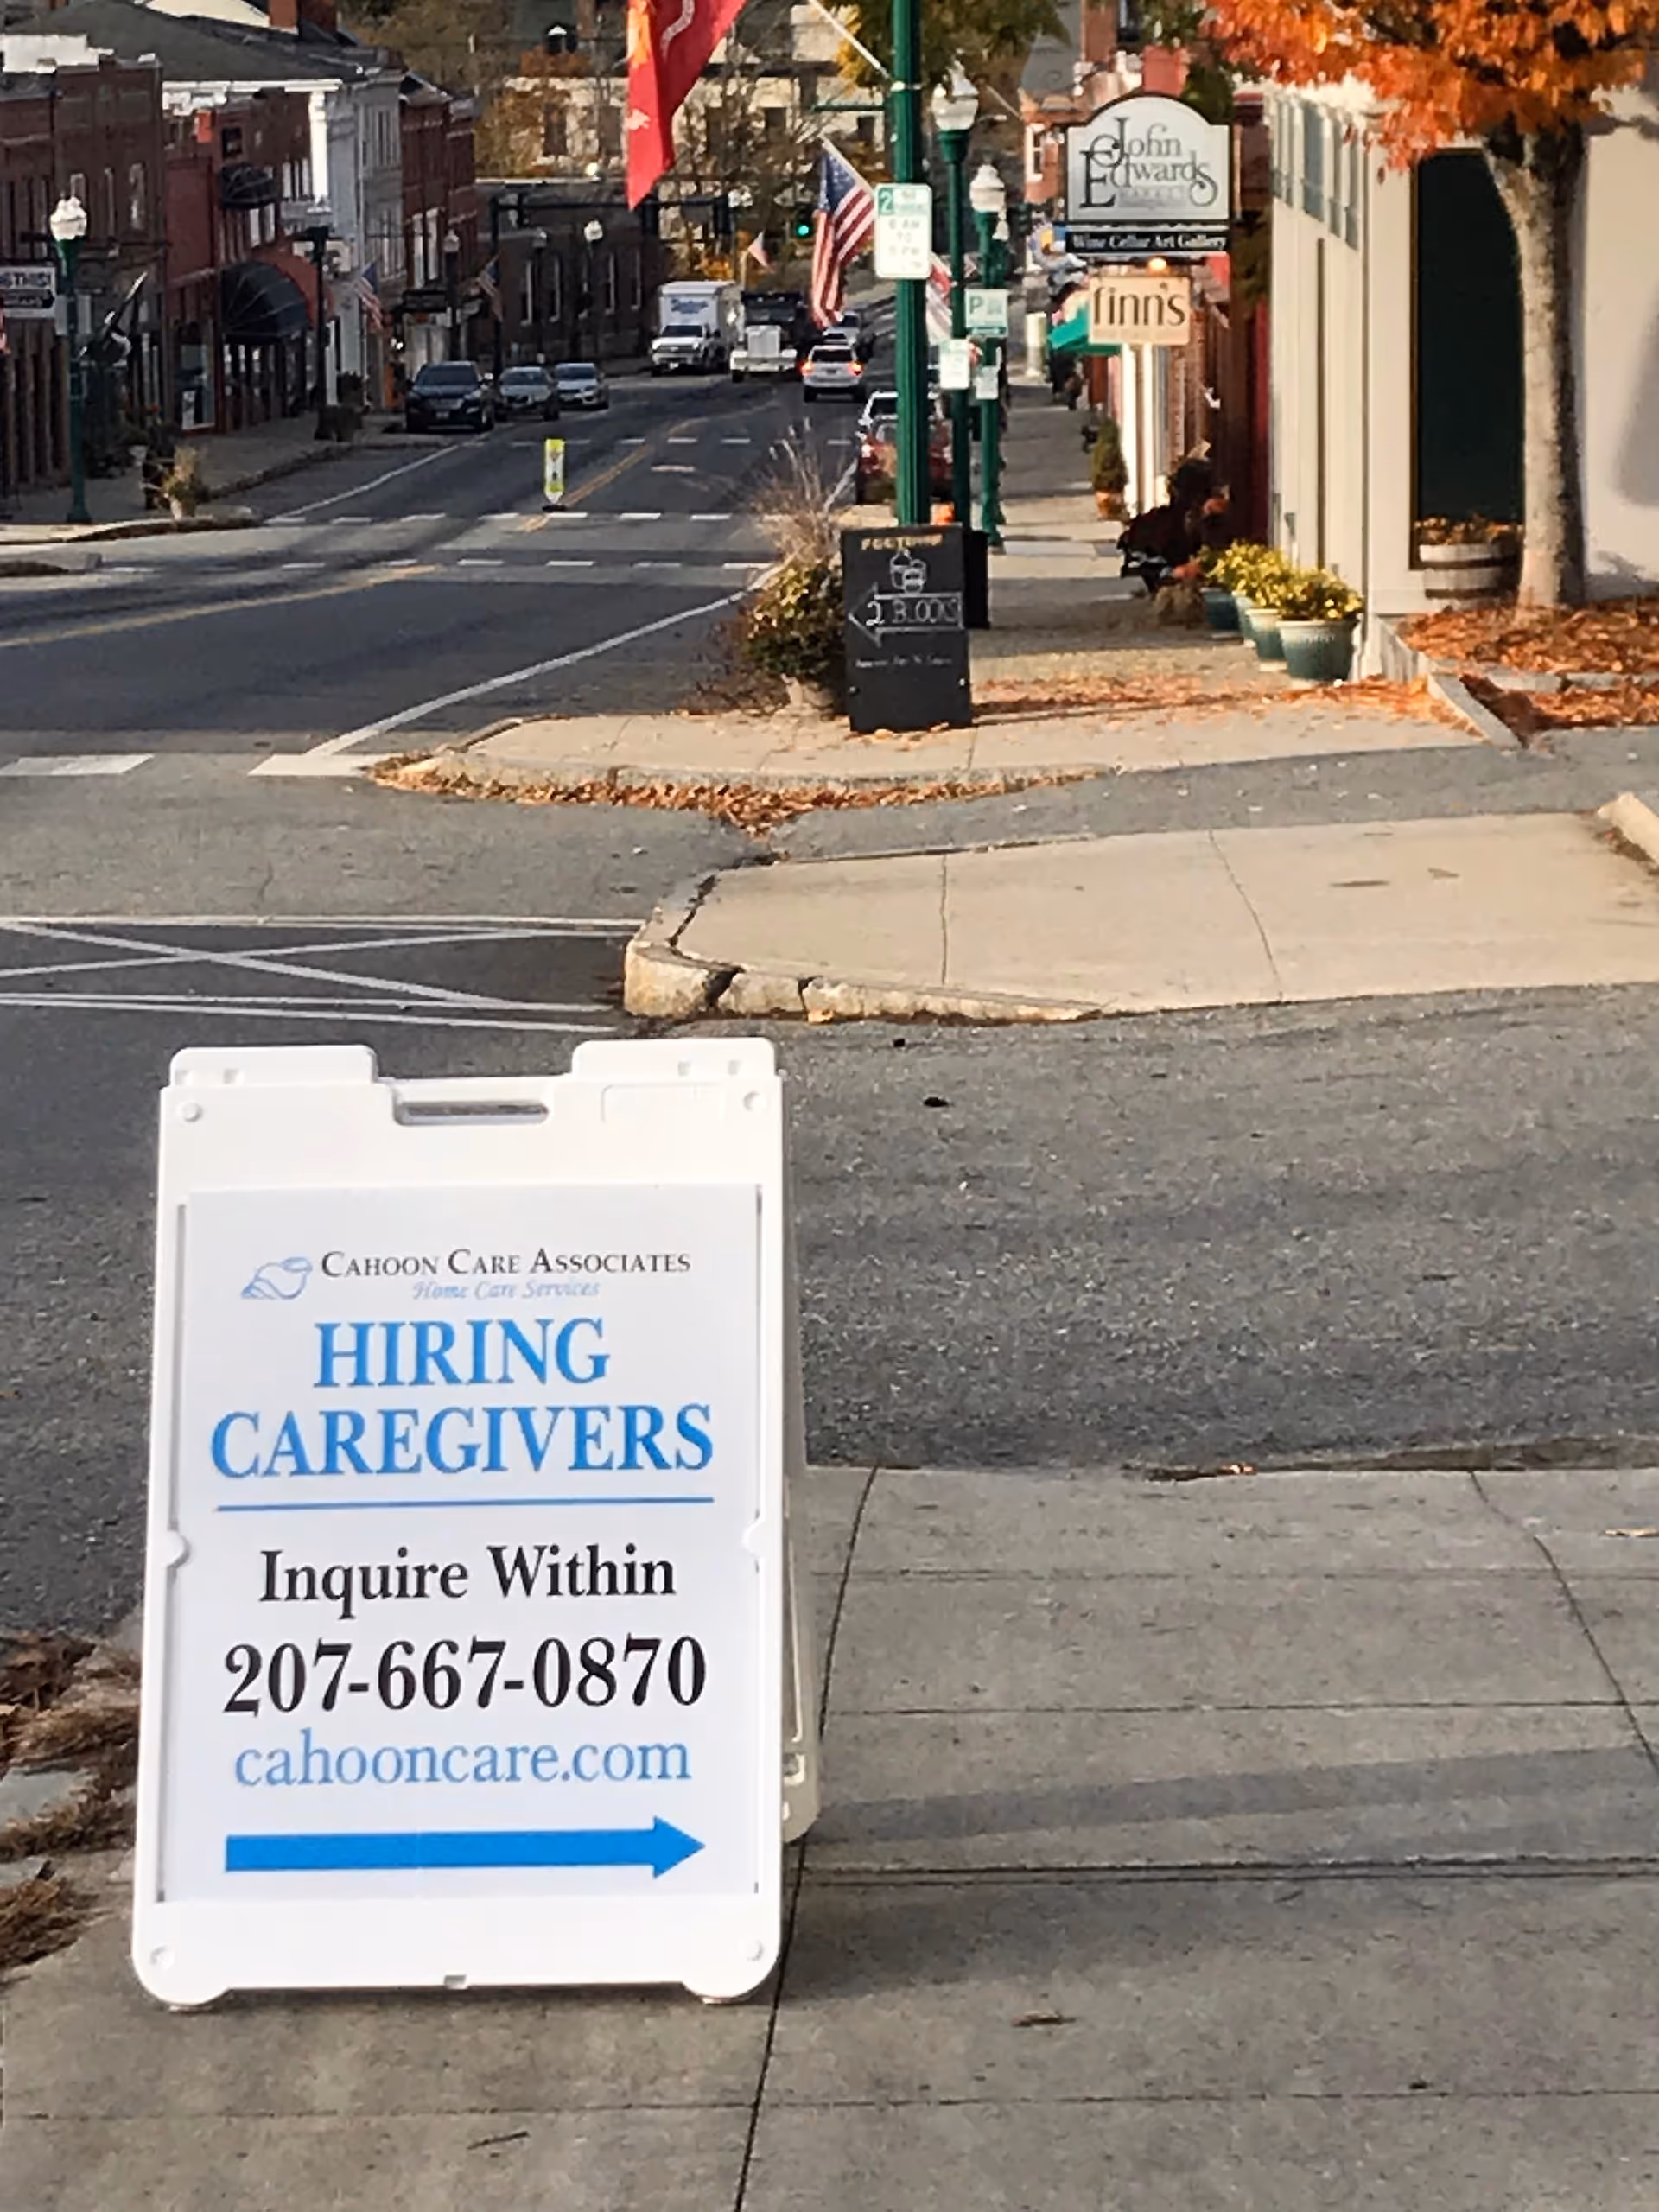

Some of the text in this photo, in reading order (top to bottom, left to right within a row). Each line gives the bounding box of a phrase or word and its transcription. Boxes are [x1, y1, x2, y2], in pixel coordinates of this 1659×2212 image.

[1090, 117, 1182, 168] John
[880, 190, 893, 214] 2
[1079, 149, 1218, 208] Edwards
[1155, 234, 1175, 249] Art
[1093, 281, 1186, 327] finn's
[866, 601, 885, 626] 2
[321, 1247, 691, 1278] CAHOON CARE ASSOCIATES
[412, 1279, 600, 1300] Home Care Services
[313, 1317, 610, 1389] HIRING
[211, 1403, 714, 1478] CAREGIVERS
[259, 1542, 677, 1620] Inquire Within
[223, 1632, 707, 1717] 207-667-0870
[235, 1727, 693, 1788] cahooncare.com
